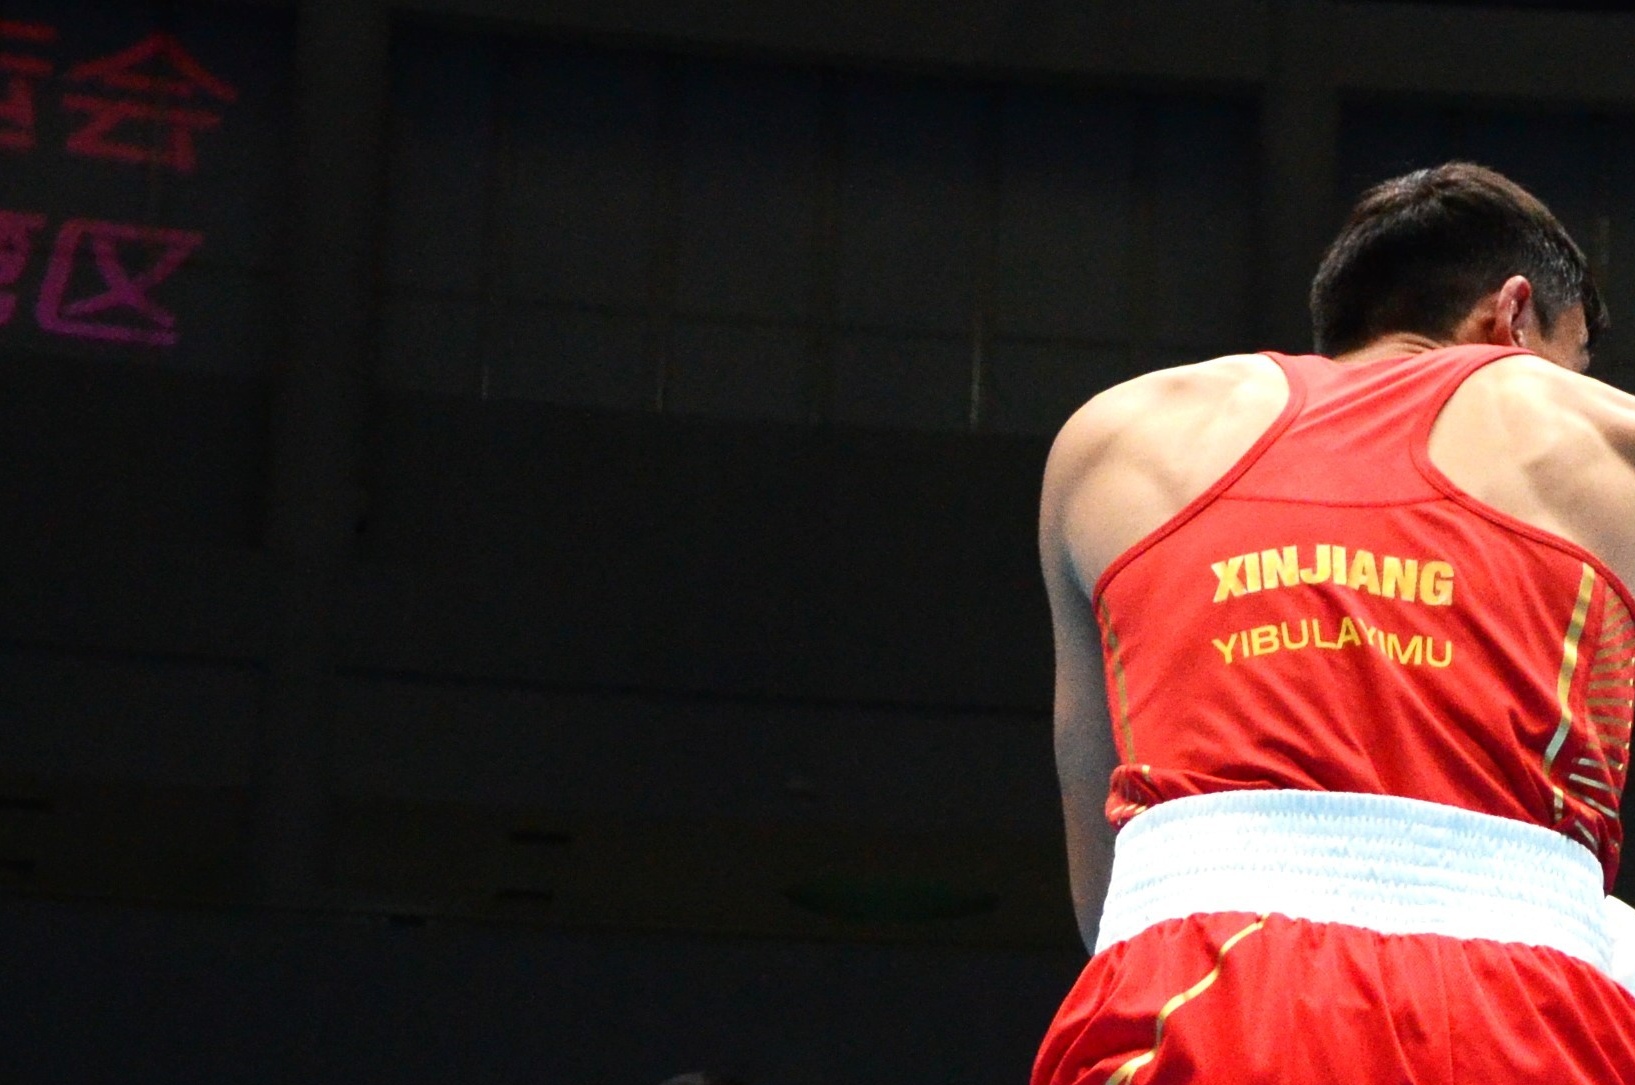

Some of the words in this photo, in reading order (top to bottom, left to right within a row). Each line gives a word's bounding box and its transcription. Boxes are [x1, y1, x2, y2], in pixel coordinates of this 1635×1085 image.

[0, 208, 204, 347] 区
[1211, 543, 1455, 606] XINJIANG
[1211, 616, 1453, 669] YIBULAYIMU
